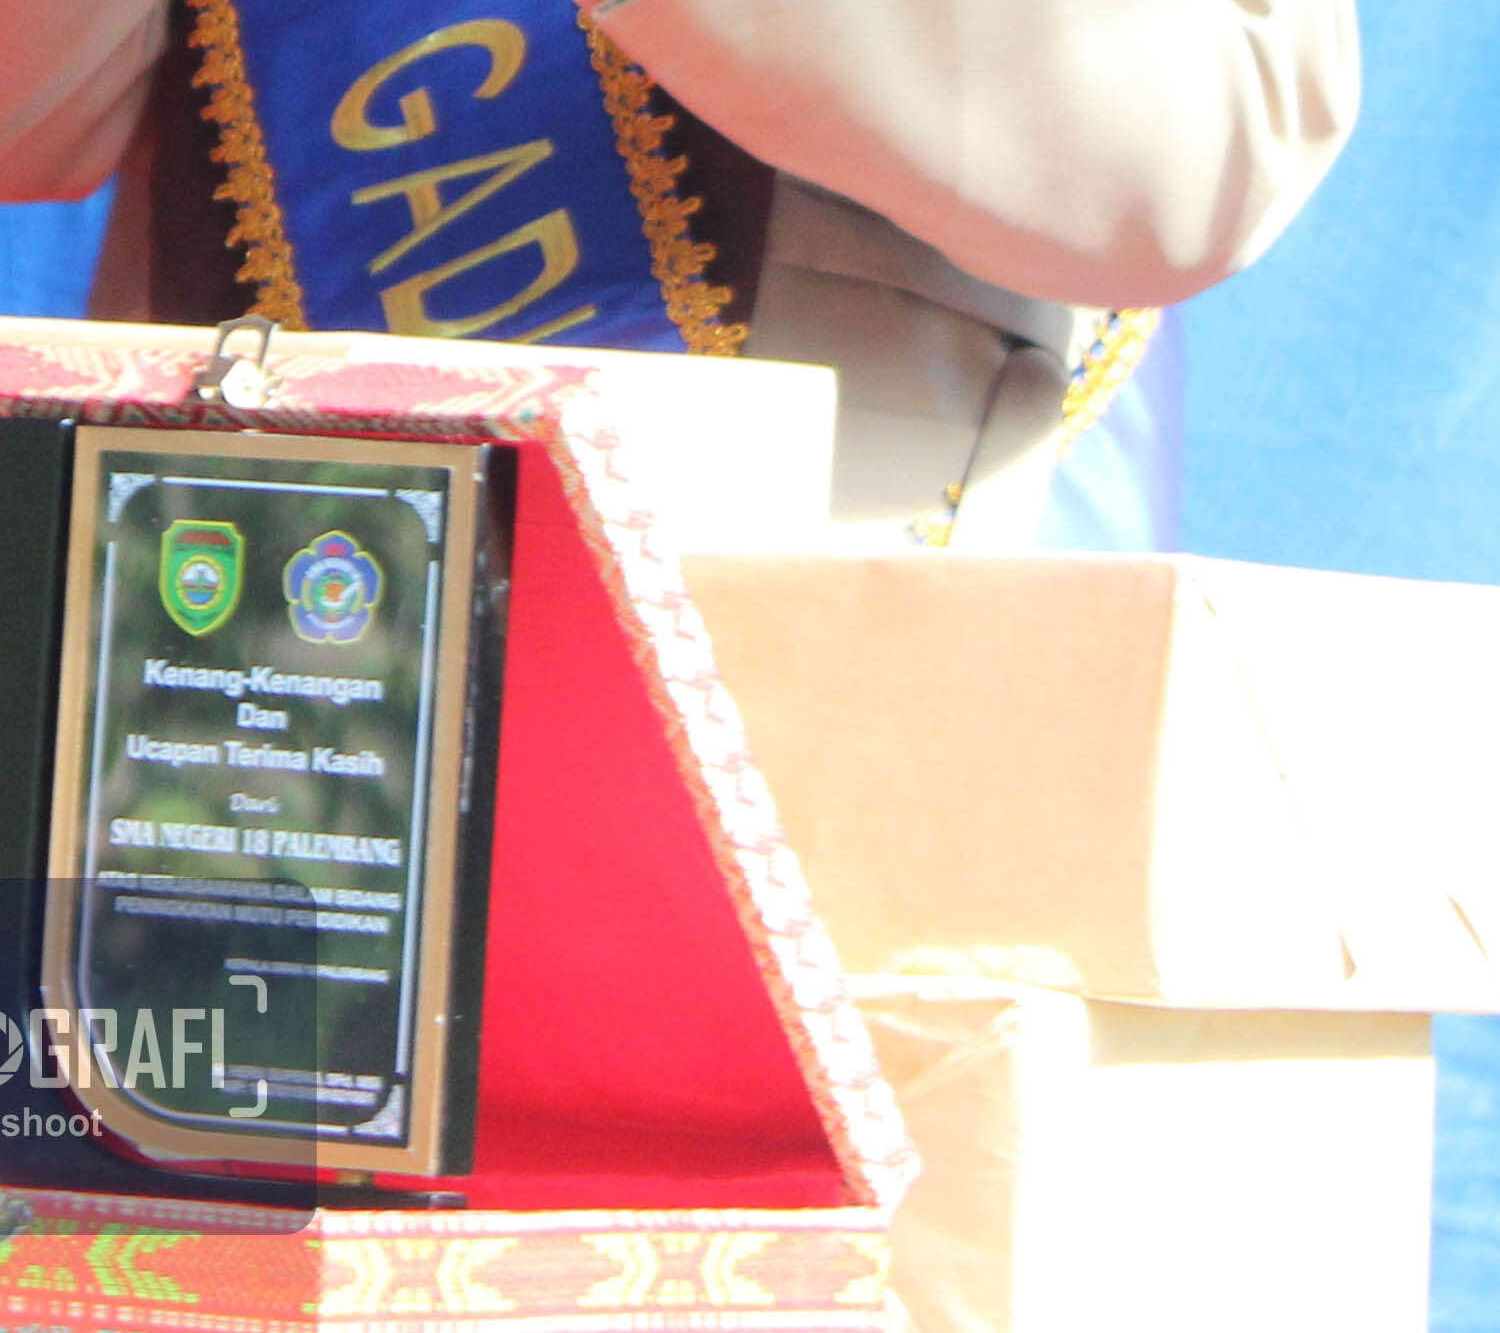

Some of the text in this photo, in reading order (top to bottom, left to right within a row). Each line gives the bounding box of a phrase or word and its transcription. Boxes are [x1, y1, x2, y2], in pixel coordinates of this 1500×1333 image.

[143, 658, 384, 706] Kenang-Kenangan
[236, 702, 288, 731] Dan
[126, 733, 385, 777] Ucapan Terima Kasih
[228, 793, 281, 813] Dari
[109, 818, 401, 868] SMA NEGERI 18 PALEMBANG
